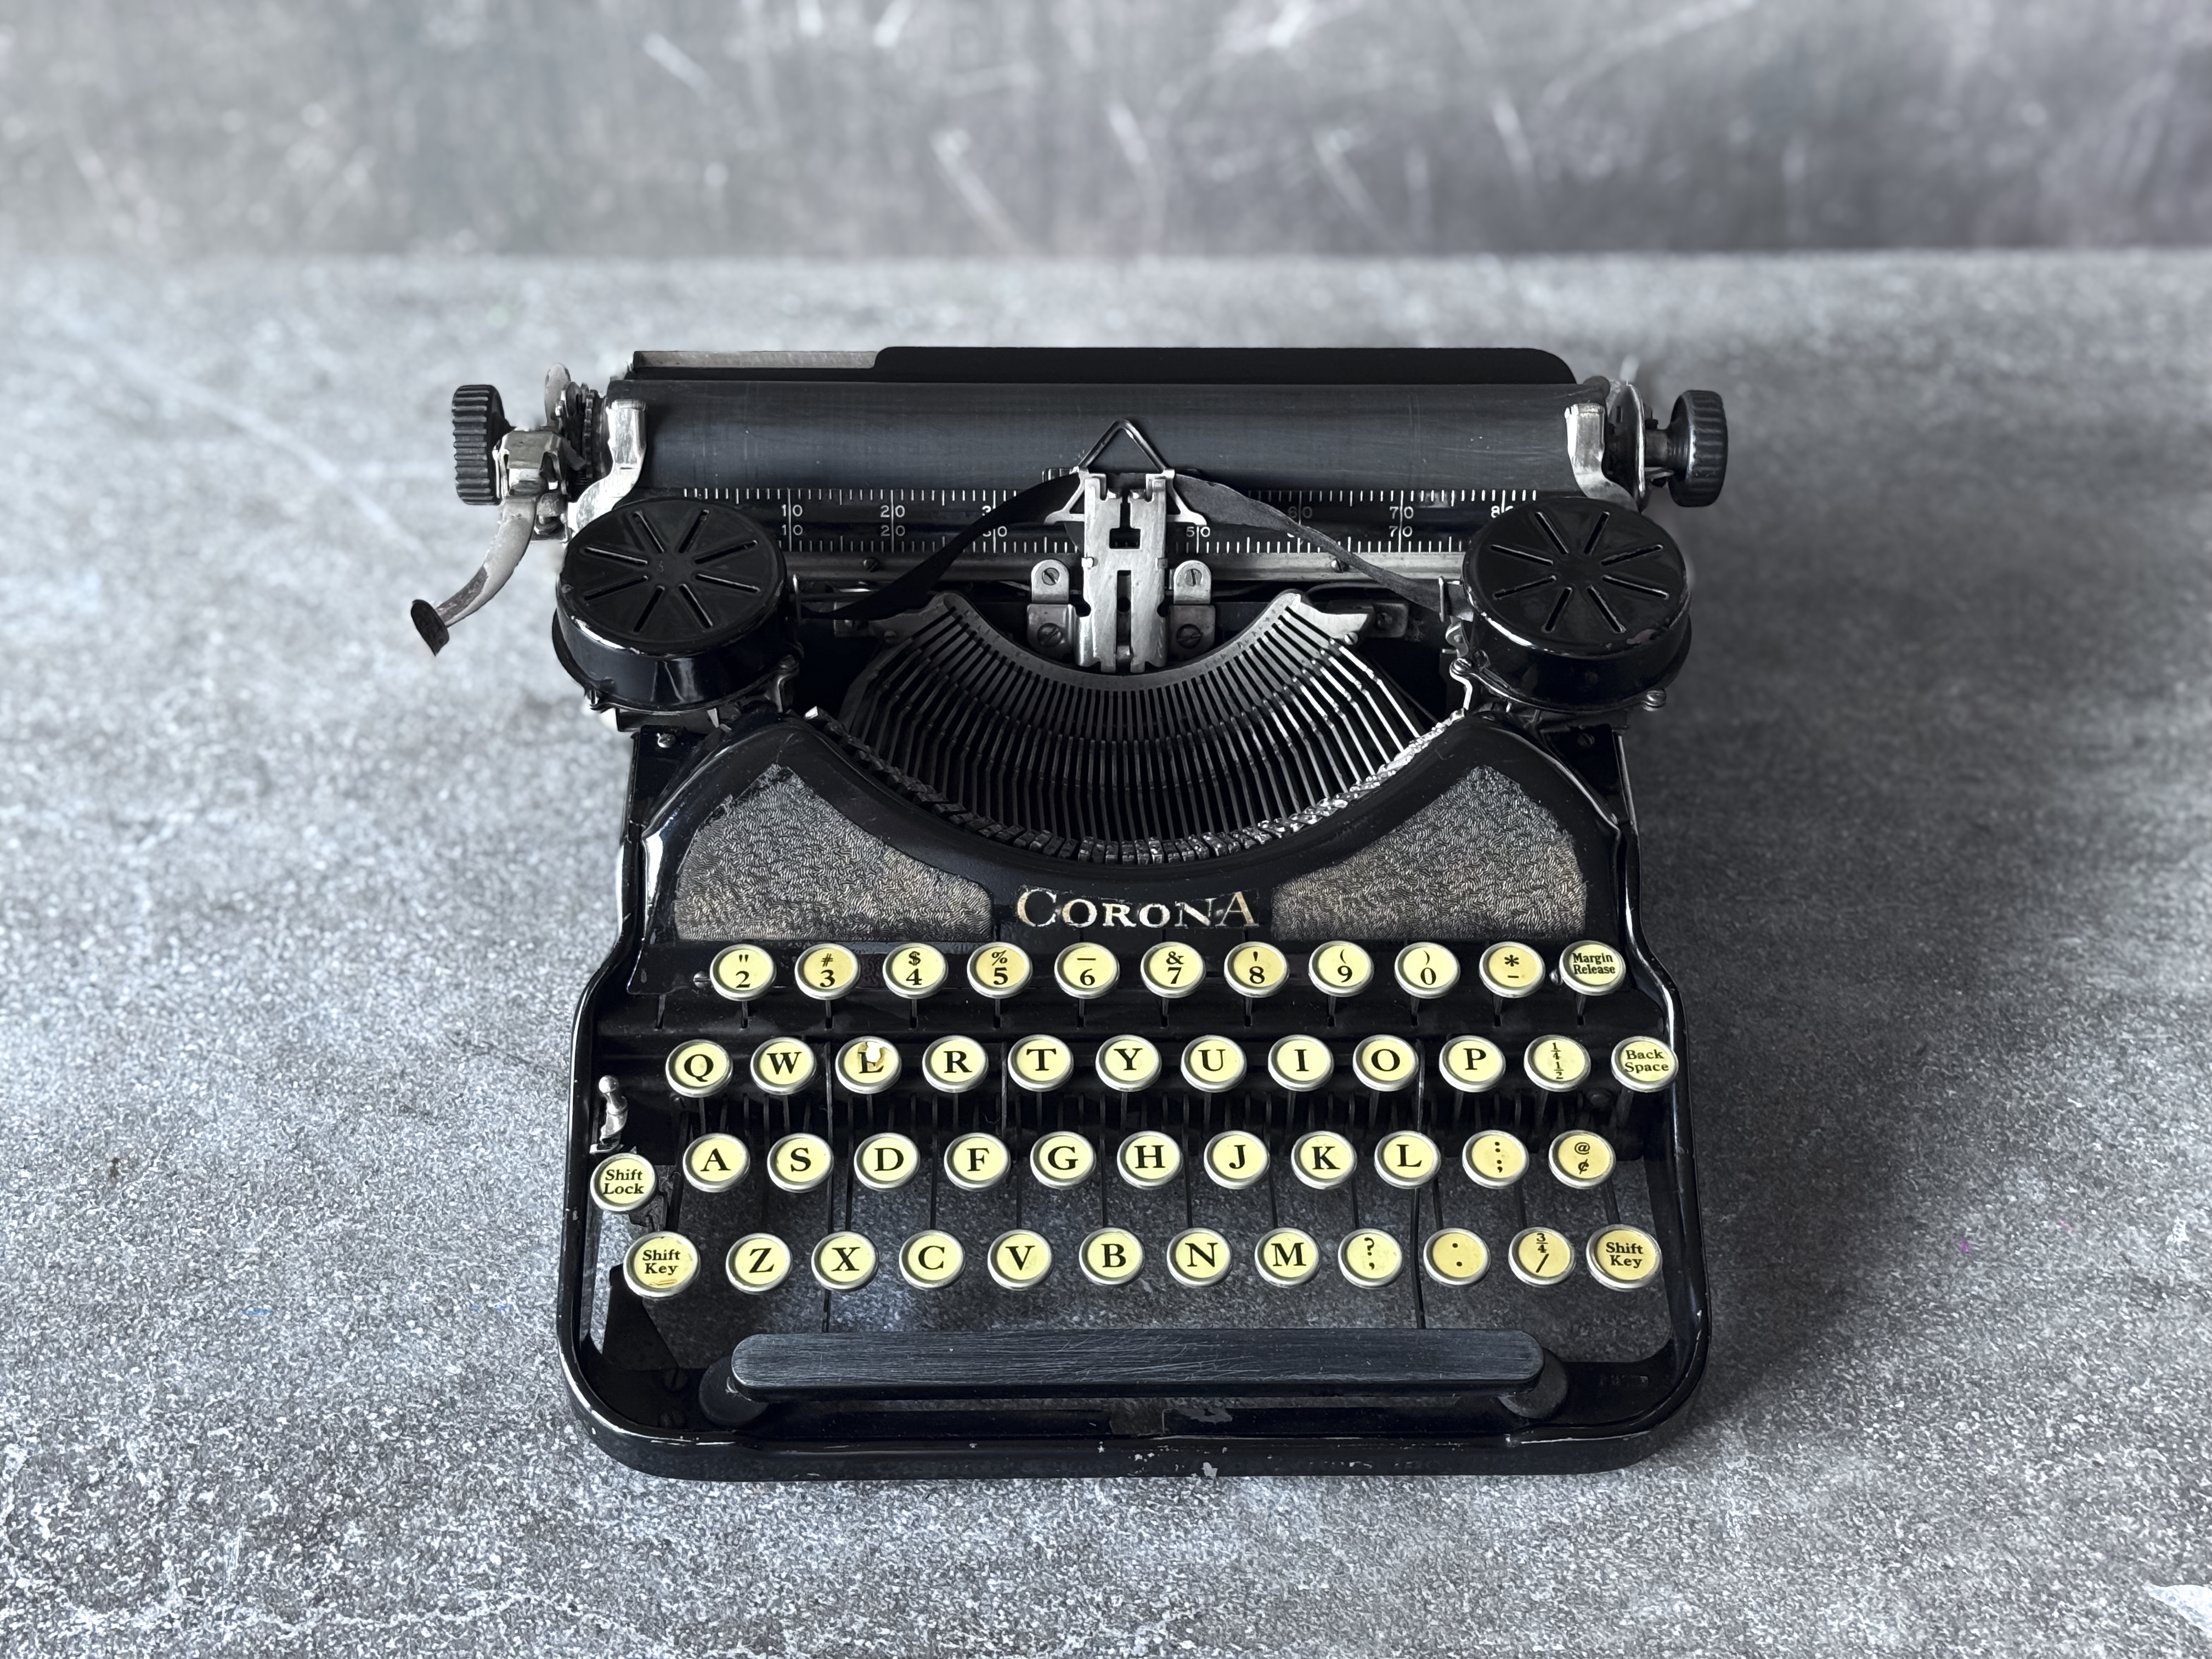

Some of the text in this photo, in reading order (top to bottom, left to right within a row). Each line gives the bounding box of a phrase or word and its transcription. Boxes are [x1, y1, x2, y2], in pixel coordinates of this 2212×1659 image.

[781, 504, 803, 517] 10
[880, 504, 905, 518] 20
[1287, 506, 1313, 519] 60
[1389, 506, 1414, 520] 70
[781, 524, 803, 536] 10
[880, 524, 906, 537] 20
[1186, 526, 1211, 538] 50
[1389, 525, 1413, 538] 70
[1017, 889, 1260, 928] CORONA
[821, 953, 833, 967] #
[908, 951, 921, 966] $
[991, 950, 1008, 966] %
[1166, 951, 1184, 965] &
[1340, 950, 1346, 964] (
[1425, 951, 1430, 965] )
[1572, 952, 1613, 965] Margin
[820, 969, 836, 988] 3
[906, 968, 922, 986] 4
[993, 967, 1008, 985] 5
[1080, 968, 1096, 986] 6
[1167, 967, 1182, 984] 7
[1249, 966, 1265, 984] 8
[1337, 965, 1353, 983] 9
[1573, 964, 1616, 975] Release
[736, 970, 751, 989] 2
[766, 1051, 802, 1075] W
[944, 1051, 973, 1074] R
[1026, 1048, 1057, 1071] T
[1113, 1048, 1143, 1071] Y
[1198, 1049, 1226, 1071] U
[1294, 1048, 1309, 1072] I
[1371, 1048, 1401, 1072] O
[1463, 1048, 1487, 1070] P
[1626, 1049, 1664, 1060] Back
[684, 1054, 714, 1082] Q
[1624, 1062, 1669, 1074] Space
[1047, 1146, 1079, 1170] G
[1134, 1145, 1165, 1169] H
[1229, 1144, 1246, 1169] J
[1312, 1146, 1340, 1170] K
[1396, 1144, 1422, 1167] L
[1574, 1142, 1590, 1155] @
[700, 1148, 731, 1172] A
[791, 1147, 811, 1172] S
[874, 1147, 904, 1172] D
[967, 1148, 989, 1172] F
[605, 1169, 644, 1181] Shift
[603, 1183, 645, 1194] Lock
[642, 1249, 681, 1261] Shift
[1101, 1243, 1126, 1268] B
[1184, 1242, 1218, 1267] N
[1271, 1242, 1307, 1267] M
[1364, 1237, 1375, 1256] ?
[1606, 1242, 1644, 1255] Shift
[749, 1248, 774, 1273] Z
[831, 1246, 860, 1272] X
[918, 1245, 945, 1270] C
[1005, 1245, 1035, 1271] V
[1609, 1255, 1643, 1269] Key
[644, 1262, 679, 1276] Key
